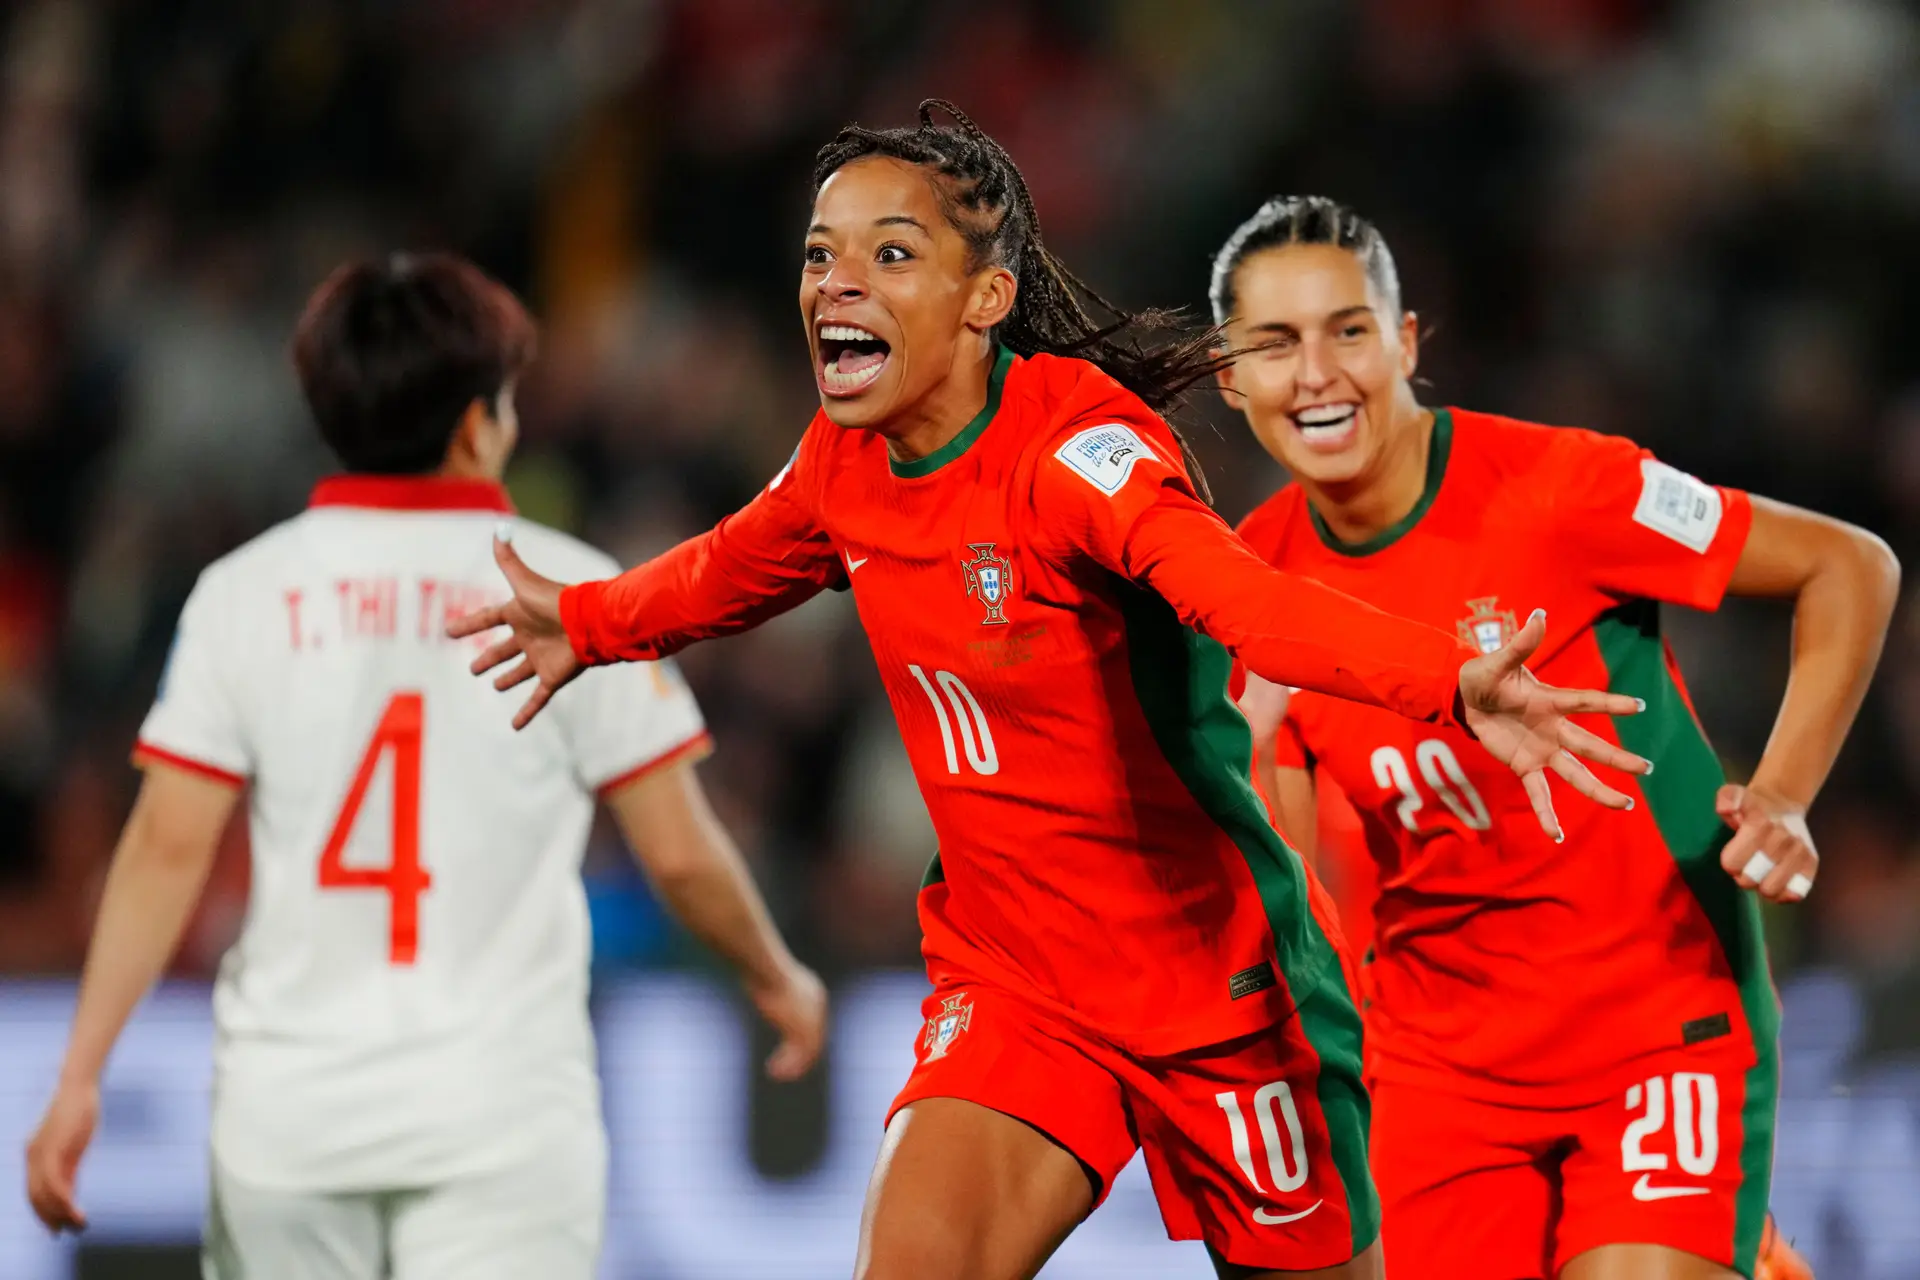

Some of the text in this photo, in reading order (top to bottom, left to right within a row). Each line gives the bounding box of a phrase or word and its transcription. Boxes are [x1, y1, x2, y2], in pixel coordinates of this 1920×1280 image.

[1076, 431, 1118, 453] FOOTBALL
[1083, 434, 1127, 458] UNITES
[285, 589, 323, 649] T.
[336, 578, 397, 641] THI
[908, 664, 999, 775] 10
[318, 691, 432, 966] 4
[1370, 738, 1492, 833] 20
[1215, 1080, 1309, 1194] 10
[1621, 1072, 1719, 1176] 20
